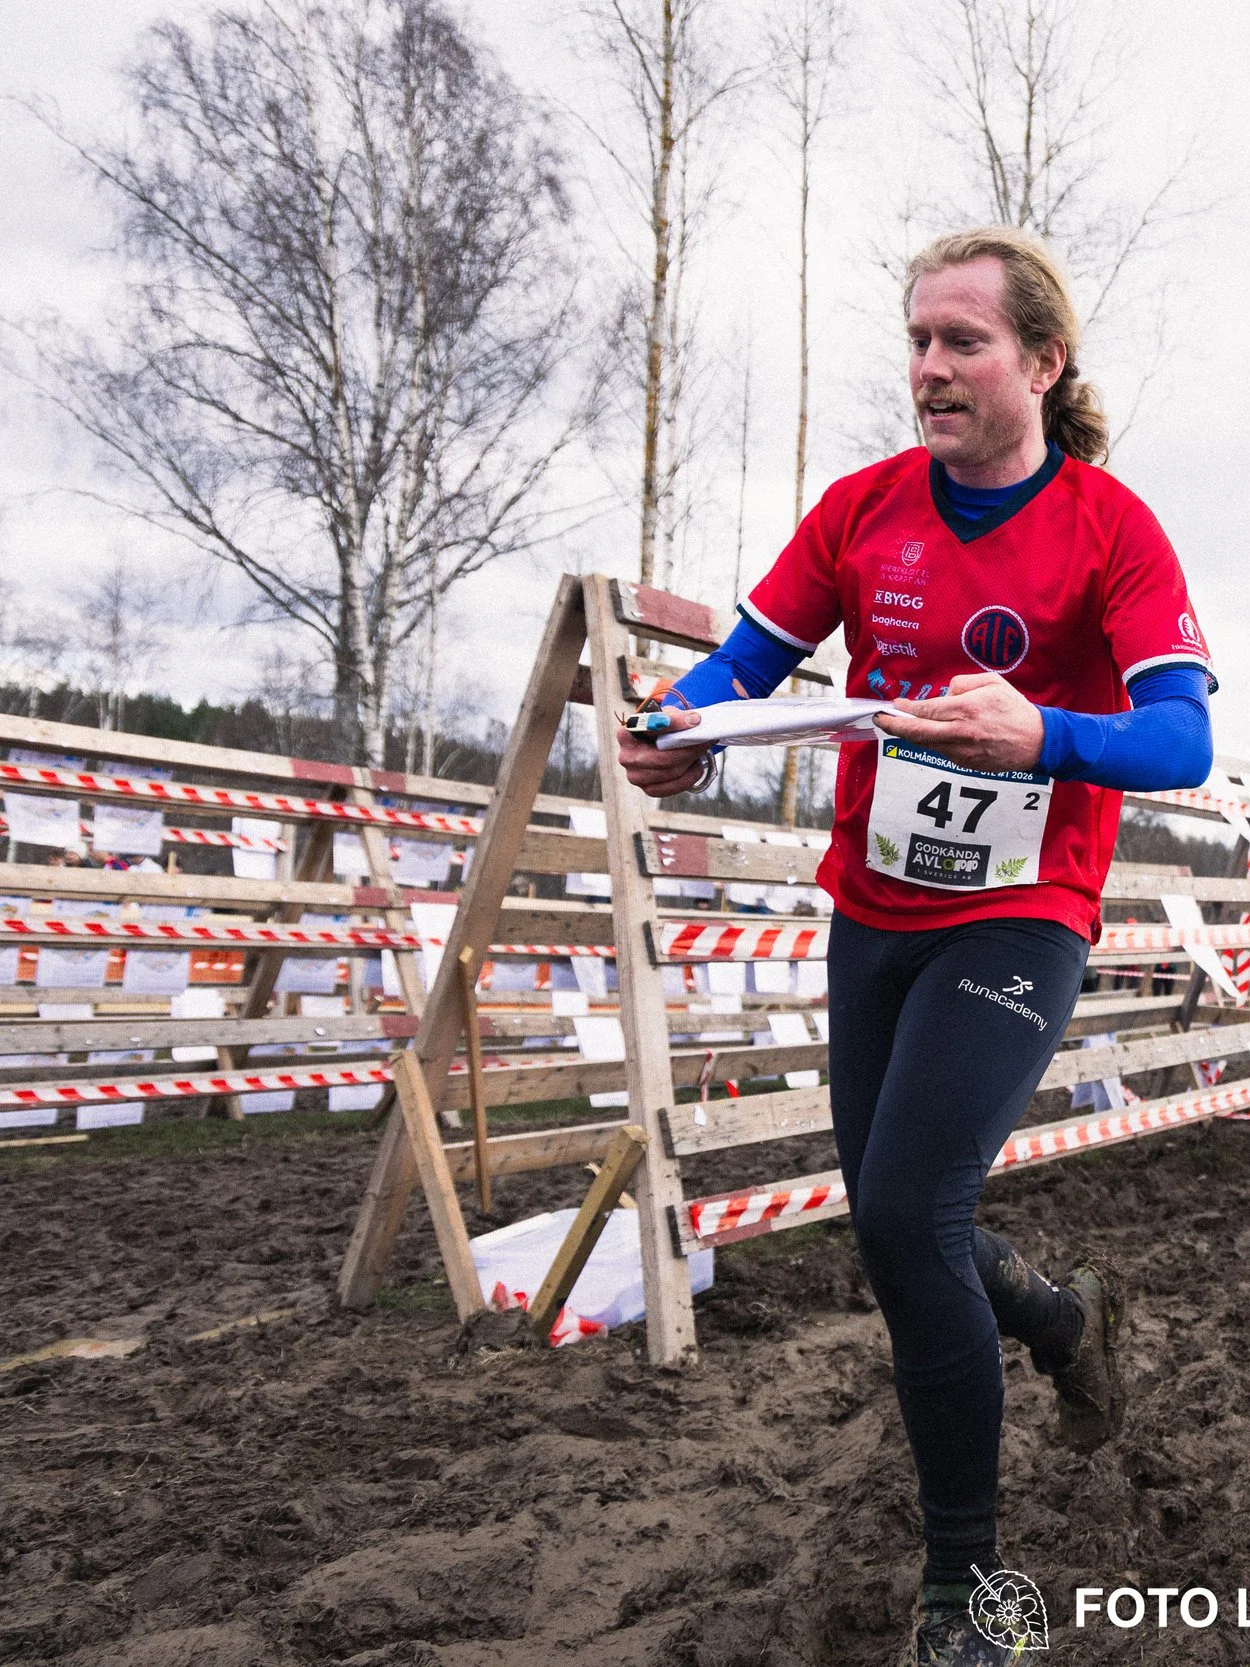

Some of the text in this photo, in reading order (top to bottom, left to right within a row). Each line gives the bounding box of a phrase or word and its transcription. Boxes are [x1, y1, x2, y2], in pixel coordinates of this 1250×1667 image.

[872, 614, 920, 630] bagheera
[971, 616, 1018, 663] AIF
[1011, 771, 1034, 781] 2026
[916, 781, 998, 834] 47
[1023, 792, 1040, 811] 2
[915, 842, 981, 860] GODKÄNDA
[958, 978, 1048, 1031] Runacademy
